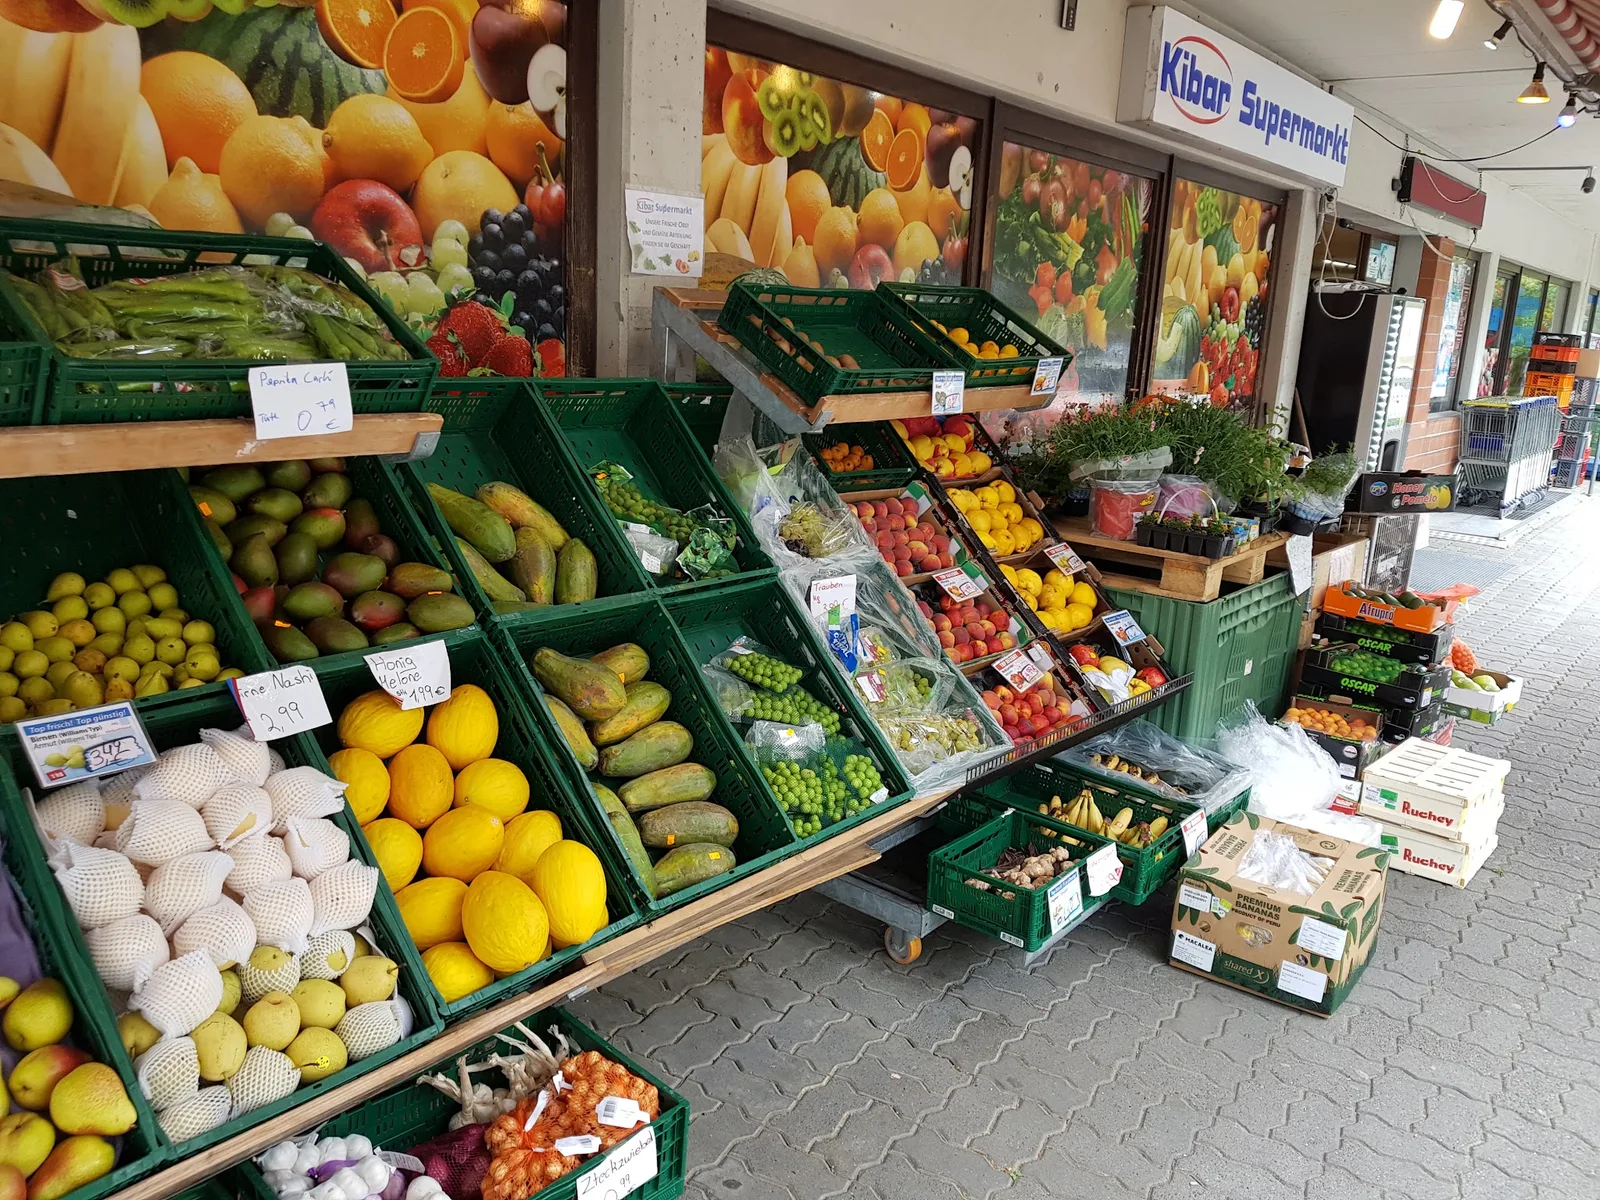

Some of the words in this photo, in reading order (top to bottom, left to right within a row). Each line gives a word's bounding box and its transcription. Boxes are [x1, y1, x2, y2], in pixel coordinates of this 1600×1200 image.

[1160, 40, 1232, 116] Kibar
[1238, 79, 1348, 165] Supermarkt
[636, 200, 654, 211] Kibar
[655, 203, 692, 215] Supermarkt
[1392, 482, 1425, 493] Honey
[1401, 494, 1437, 505] Pomelo
[814, 582, 842, 592] Trauben
[1359, 602, 1394, 620] Afrupro
[1358, 638, 1392, 652] OSCAR
[370, 656, 417, 672] Honig
[238, 686, 266, 698] irne
[272, 670, 314, 690] Nashi
[379, 671, 422, 690] Melone
[1341, 678, 1376, 694] OSCAR
[29, 726, 46, 734] Top
[47, 720, 73, 732] frisch!
[93, 709, 126, 722] günstig!
[260, 701, 304, 732] 2,99
[30, 733, 58, 743] Birnen
[59, 728, 88, 739] (Williams
[33, 739, 57, 750] Armut
[1401, 801, 1454, 826] Ruchey
[1403, 848, 1455, 874] Ruchey
[1235, 900, 1280, 921] BANANAS
[1237, 893, 1281, 914] PREMIUM
[1232, 908, 1256, 920] PRODUCT
[1265, 918, 1281, 928] PERU
[1185, 937, 1213, 952] MACALEA
[1224, 960, 1254, 976] shared
